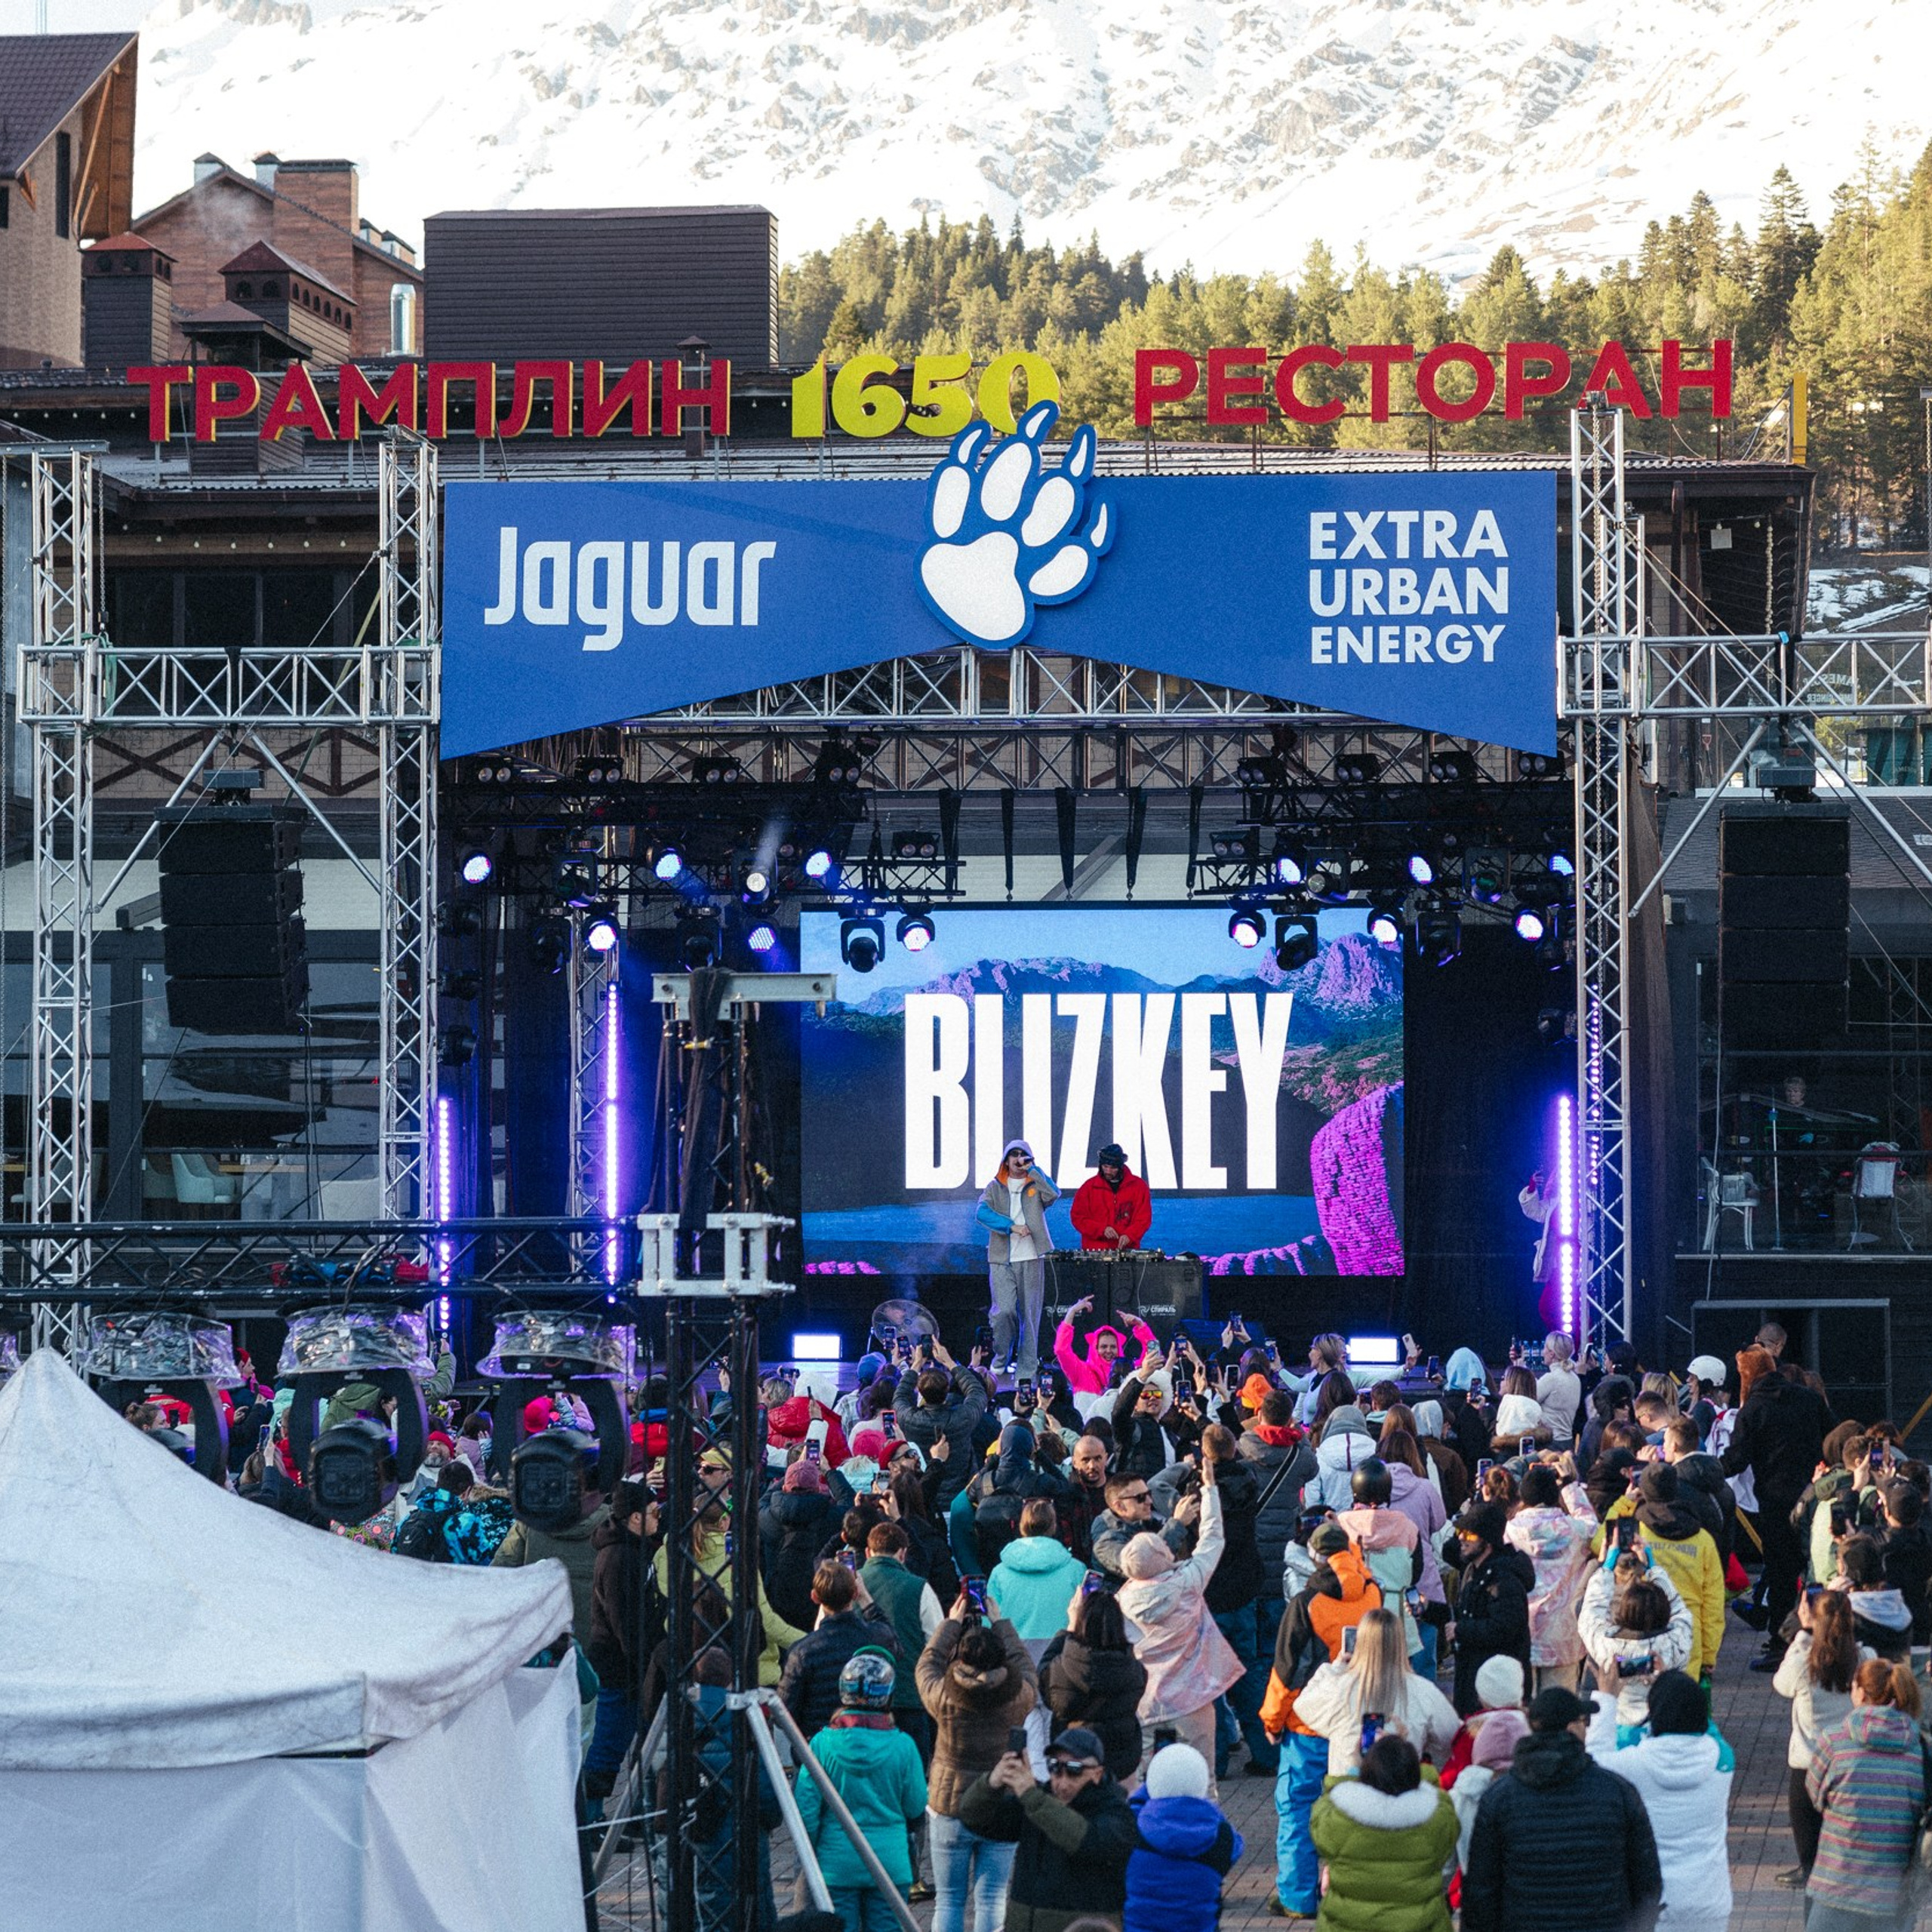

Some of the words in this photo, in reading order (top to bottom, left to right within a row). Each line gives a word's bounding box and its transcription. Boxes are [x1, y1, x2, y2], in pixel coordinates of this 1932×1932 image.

[127, 359, 732, 442] ТРАМПЛИН
[792, 352, 1061, 438] 1650
[1135, 340, 1734, 426] РЕСТОРАН
[1309, 509, 1509, 560] EXTRA
[484, 527, 777, 652] Jaguar
[1309, 566, 1509, 617] URBAN
[1311, 623, 1507, 665] ENERGY
